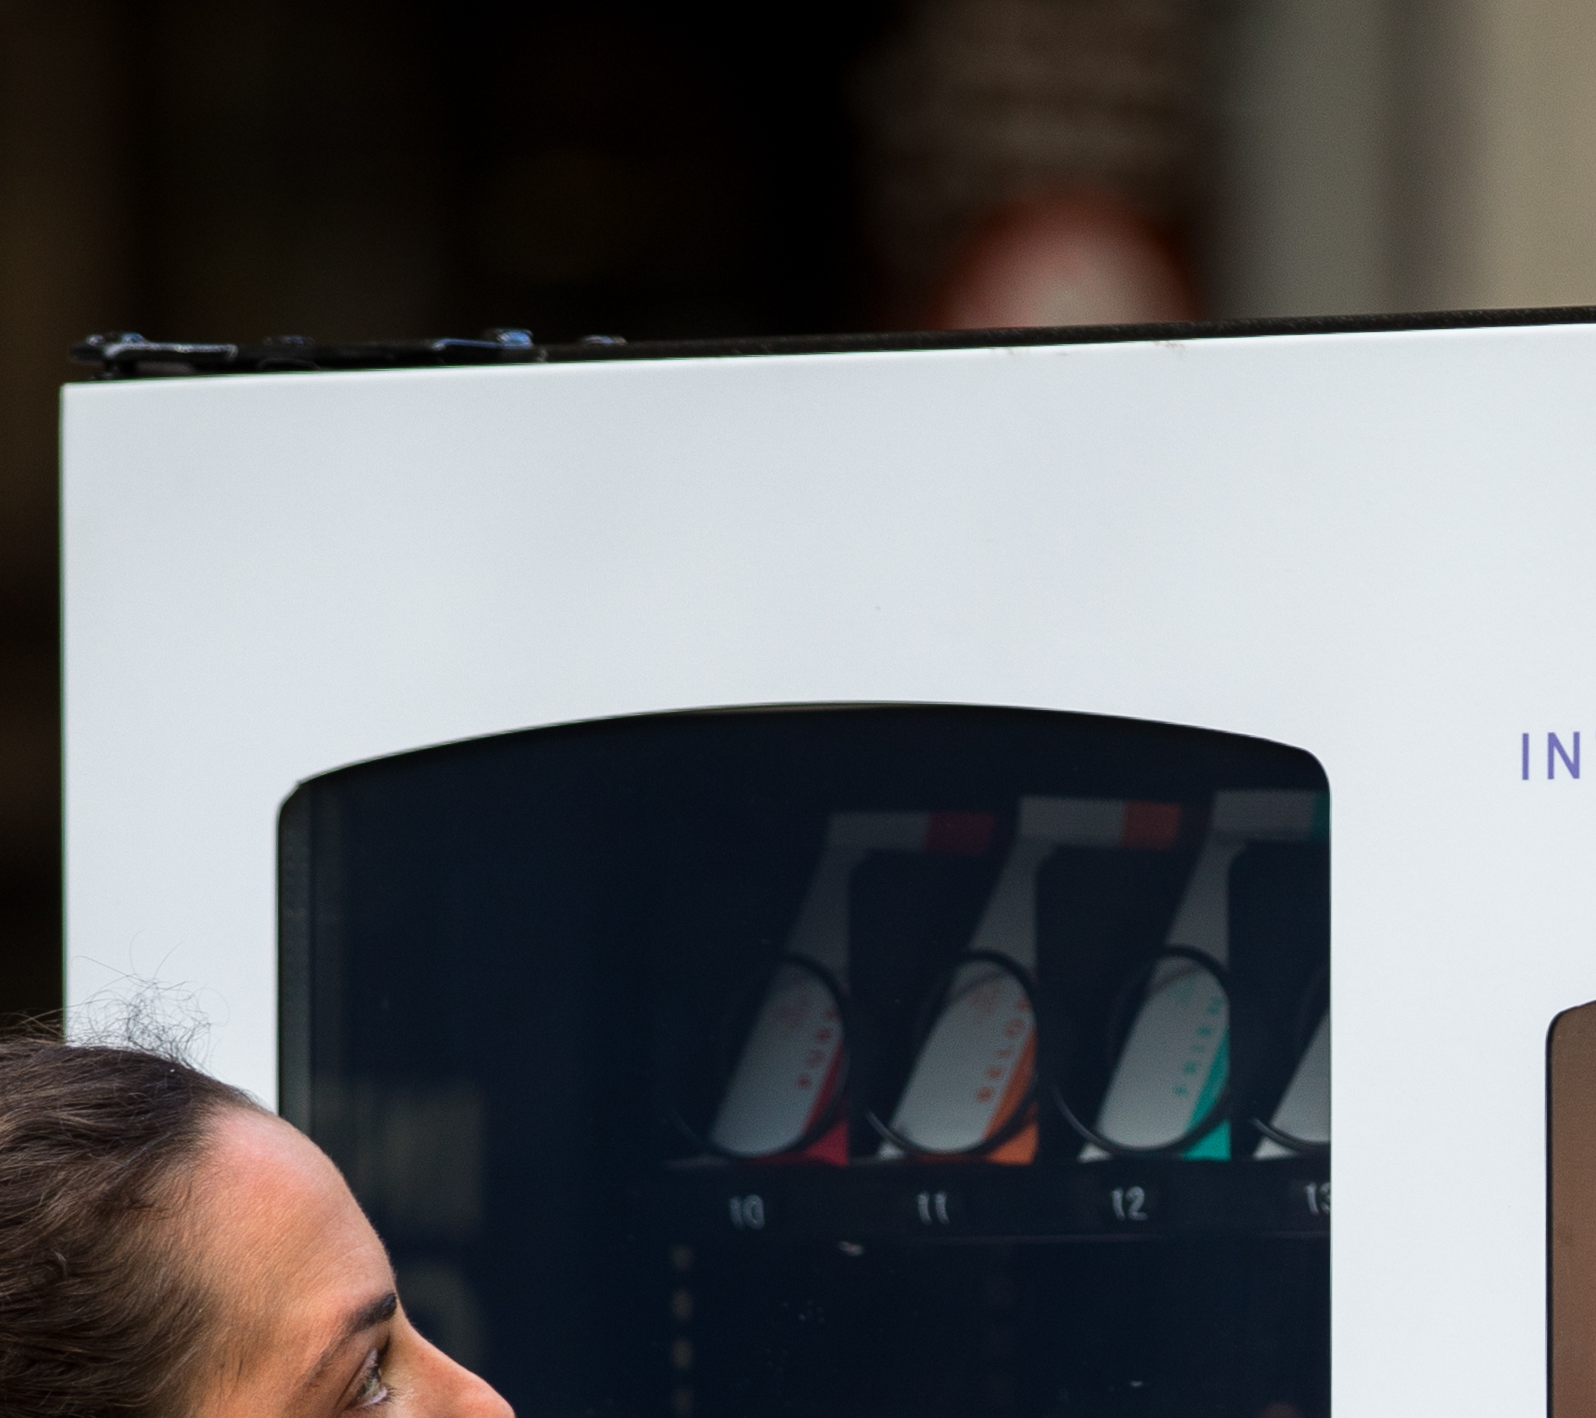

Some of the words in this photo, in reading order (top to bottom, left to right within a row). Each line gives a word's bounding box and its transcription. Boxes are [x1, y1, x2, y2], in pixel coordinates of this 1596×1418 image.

[728, 1194, 766, 1230] 10
[917, 1191, 949, 1224] 11
[1111, 1186, 1146, 1221] 12
